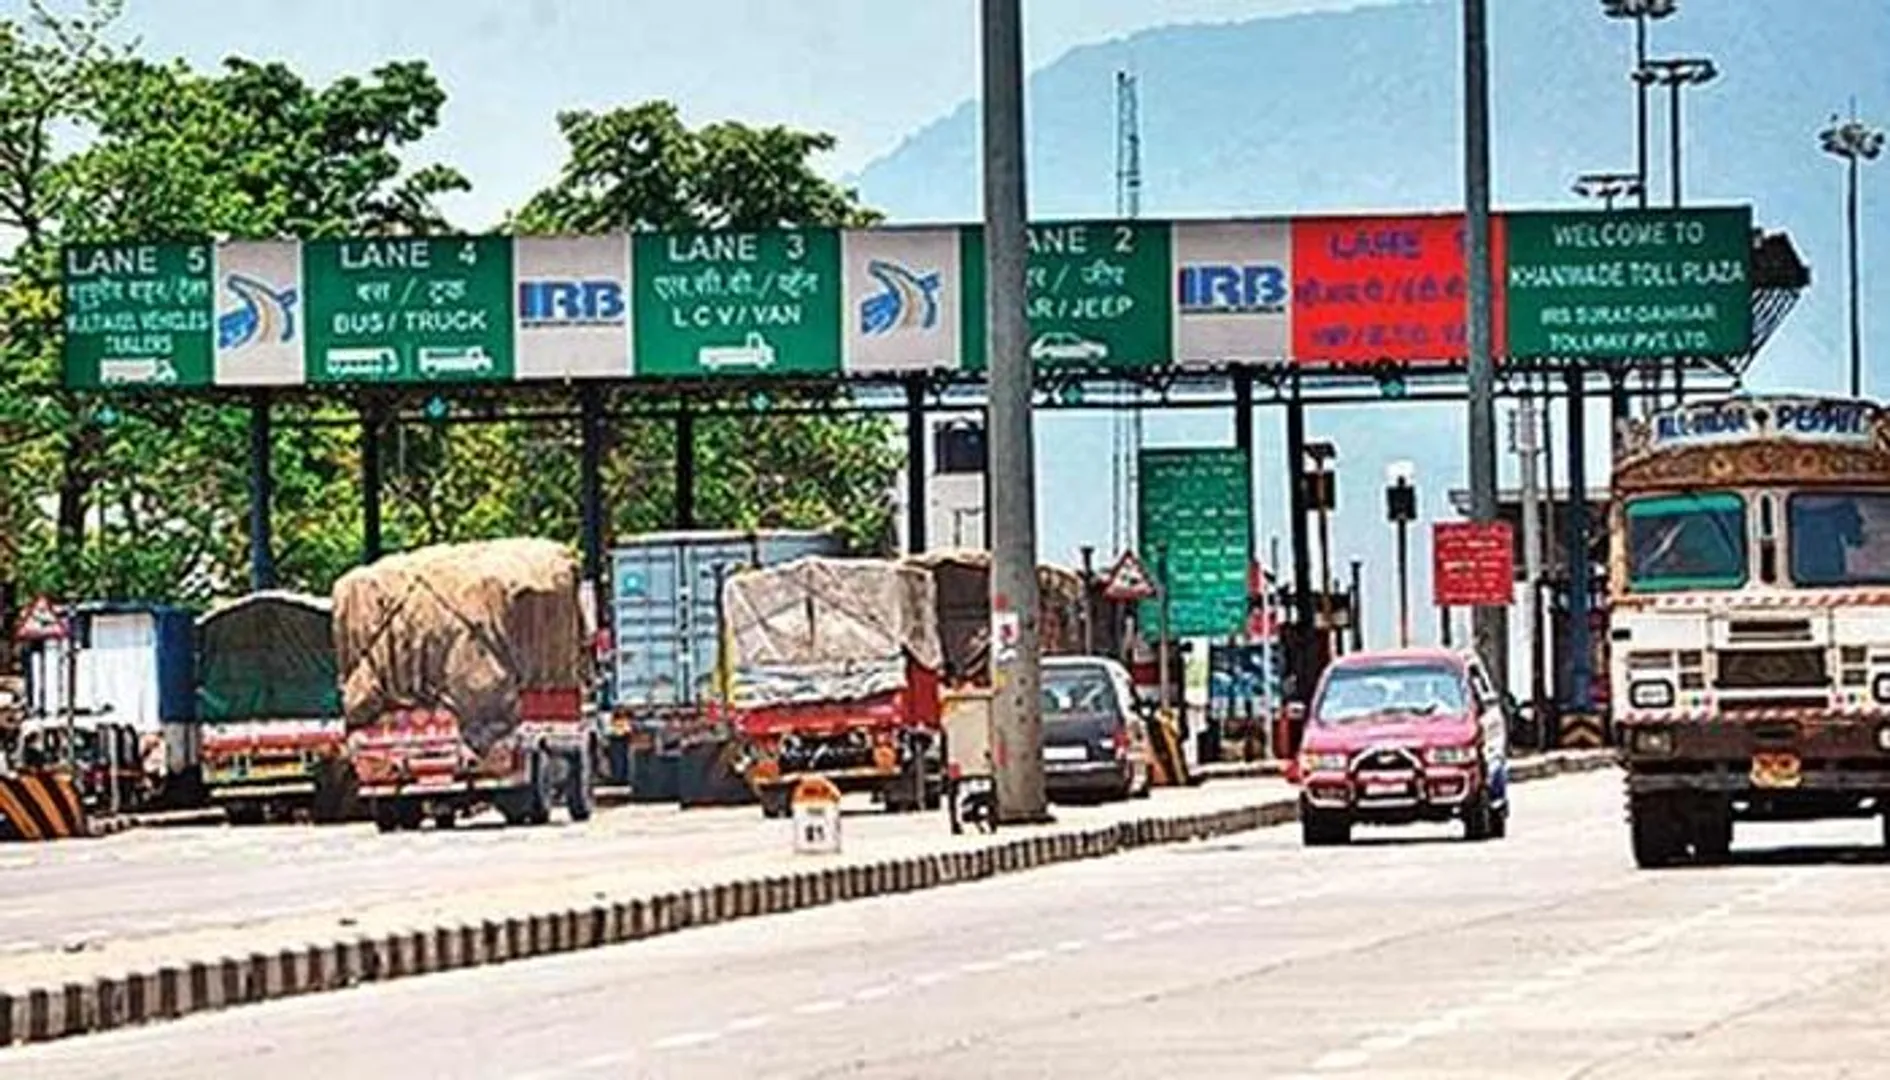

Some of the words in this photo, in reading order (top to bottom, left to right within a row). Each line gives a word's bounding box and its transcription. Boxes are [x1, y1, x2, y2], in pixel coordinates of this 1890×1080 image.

[669, 234, 757, 262] LANE
[786, 234, 806, 261] 3
[1025, 226, 1087, 254] ANE
[1114, 226, 1134, 254] 2
[1552, 221, 1666, 247] WELCOME
[1673, 221, 1705, 245] TO
[67, 246, 157, 275] LANE
[187, 246, 207, 273] 5
[340, 241, 430, 269] LANE
[457, 241, 478, 266] 4
[1177, 266, 1290, 306] IRB
[1630, 260, 1679, 287] TOLL
[1682, 259, 1746, 285] PLAZA
[518, 281, 626, 319] IRB
